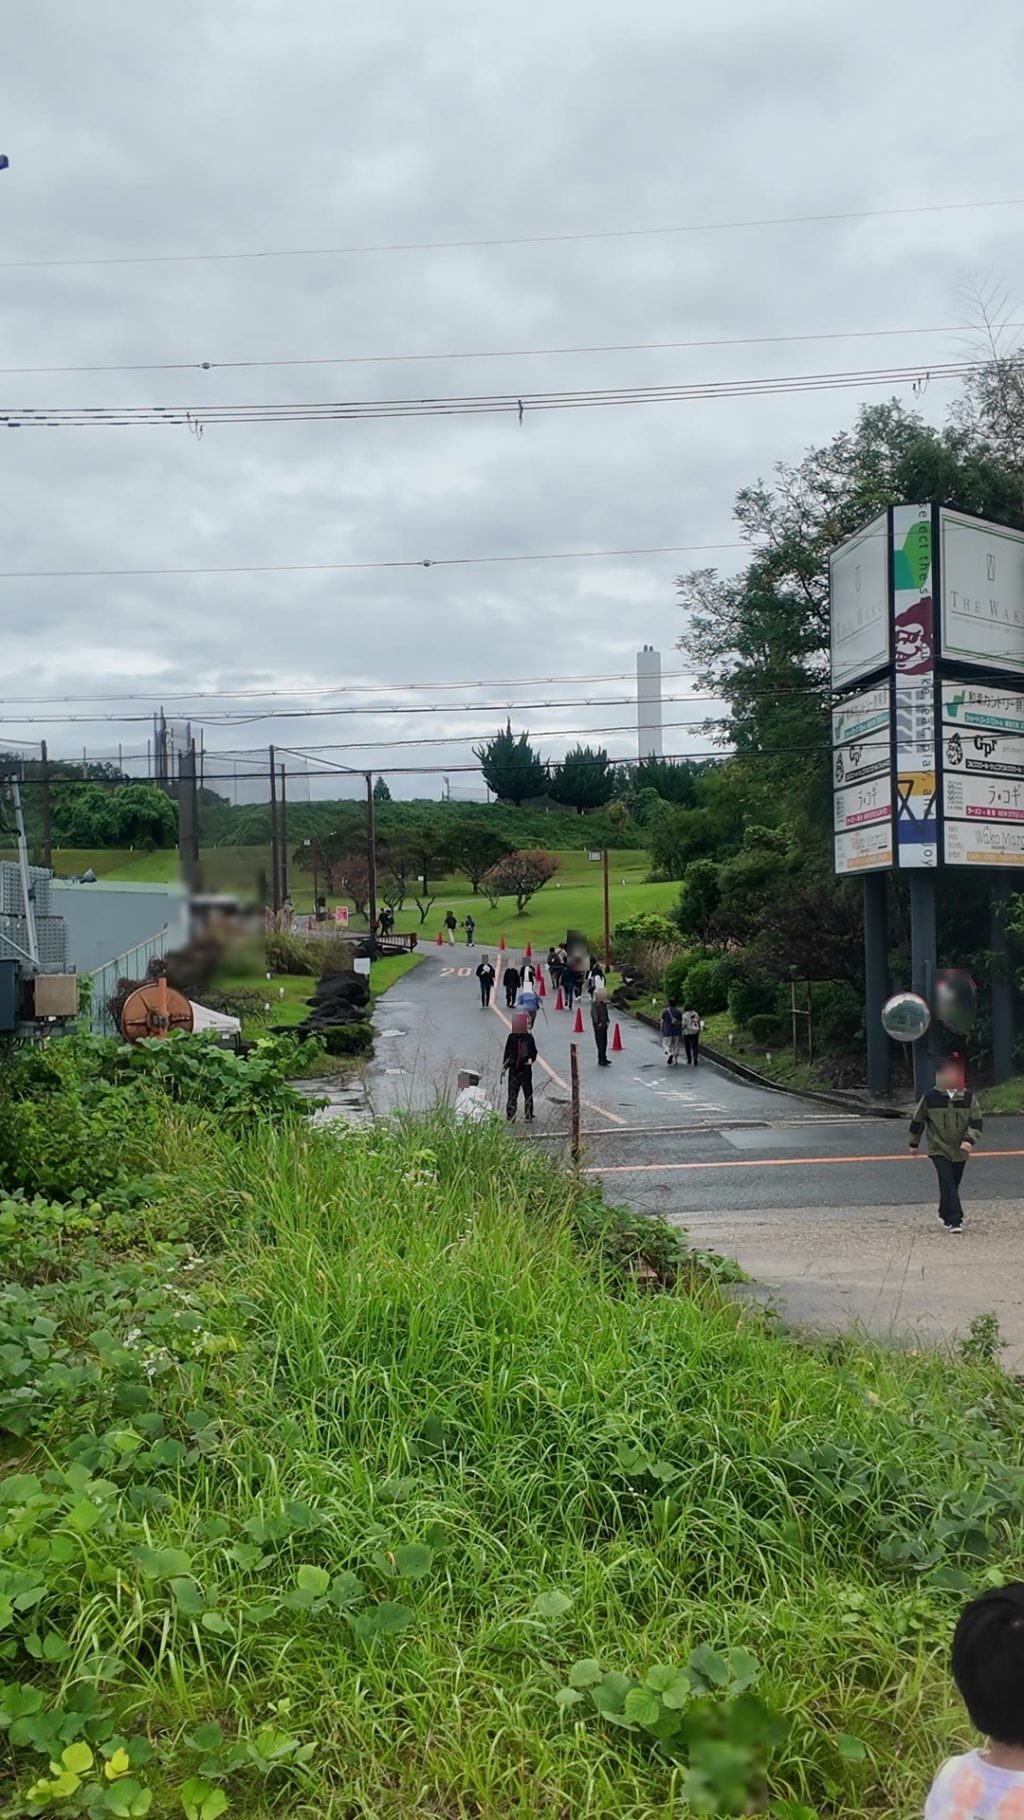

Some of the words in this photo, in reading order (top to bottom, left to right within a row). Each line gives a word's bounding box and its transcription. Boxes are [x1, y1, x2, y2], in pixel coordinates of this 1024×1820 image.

[919, 556, 930, 580] the
[989, 599, 1024, 626] WAK
[974, 735, 998, 758] Gpr
[440, 967, 472, 977] 20
